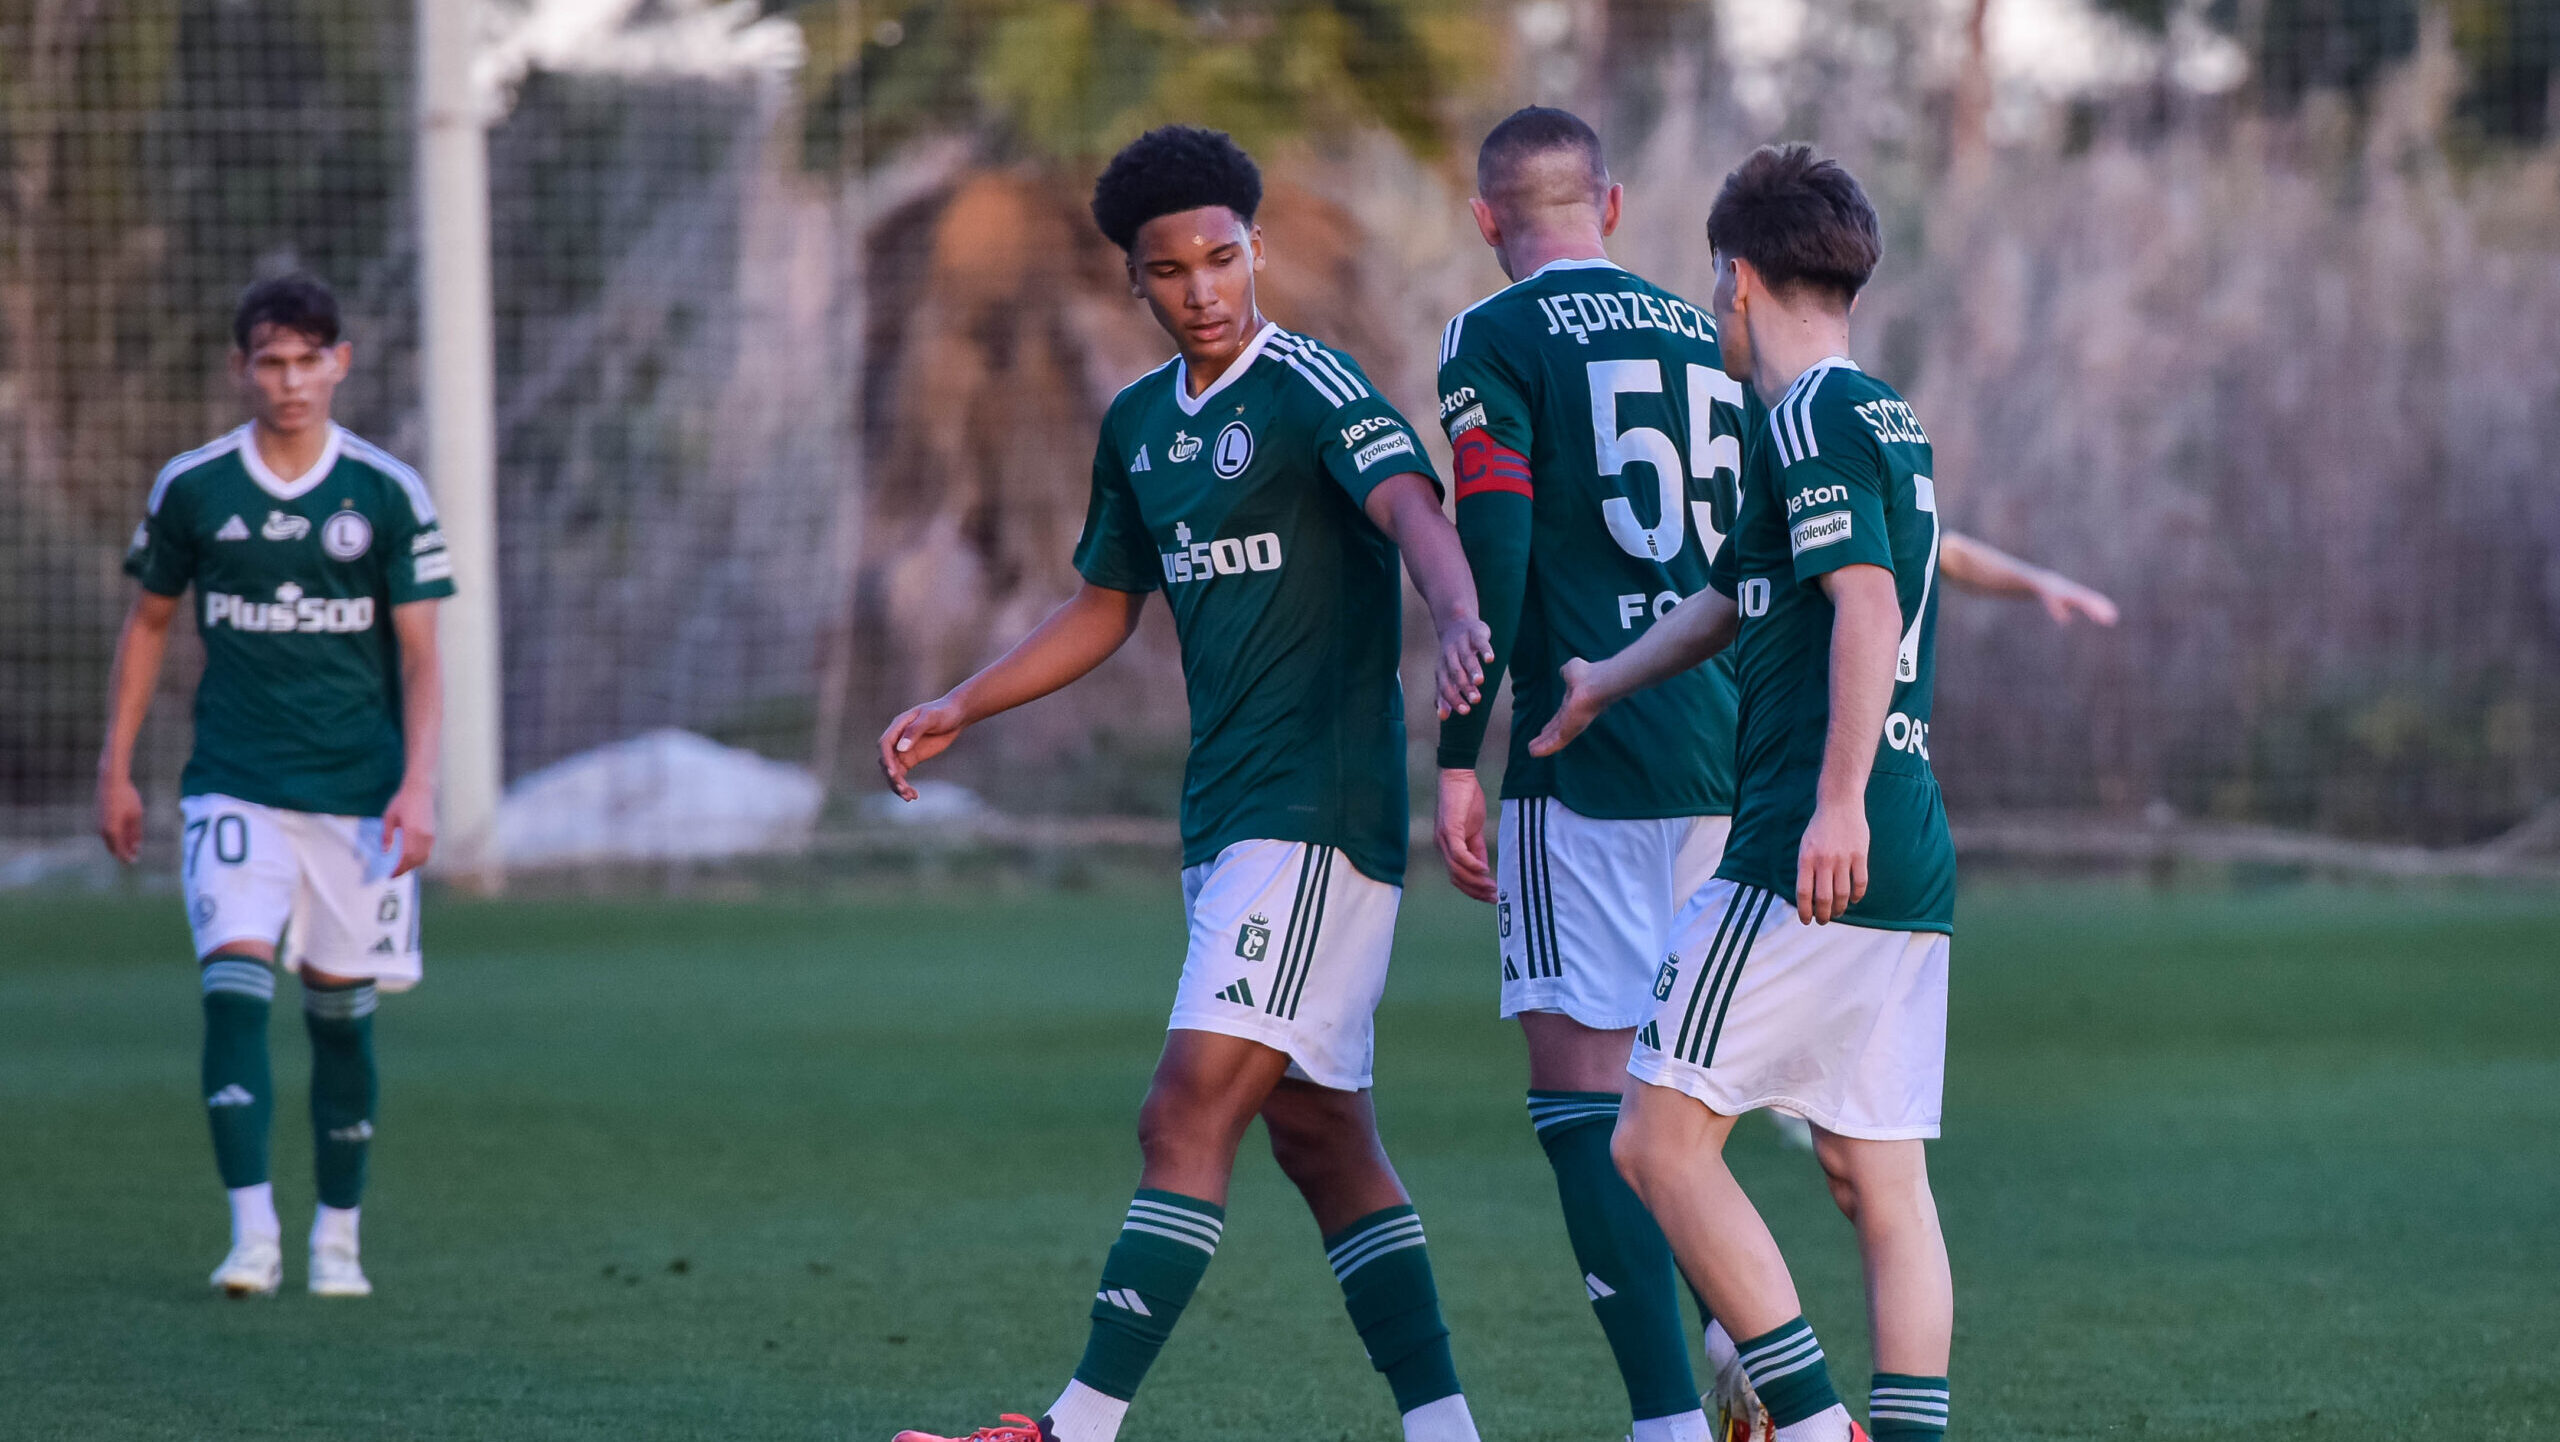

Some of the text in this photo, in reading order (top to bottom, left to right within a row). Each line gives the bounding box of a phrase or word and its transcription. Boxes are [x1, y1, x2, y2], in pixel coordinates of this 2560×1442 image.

[1538, 291, 1718, 344] JĘDRZEJCZY
[1440, 386, 1476, 419] eton
[1854, 399, 1930, 443] SZCZE
[1360, 434, 1410, 466] Królewsk
[1586, 358, 1744, 566] 55
[1793, 517, 1848, 549] Królewskie
[1161, 532, 1282, 583] us500
[205, 591, 376, 634] Plus500
[1618, 590, 1683, 630] FO
[186, 813, 248, 878] 70
